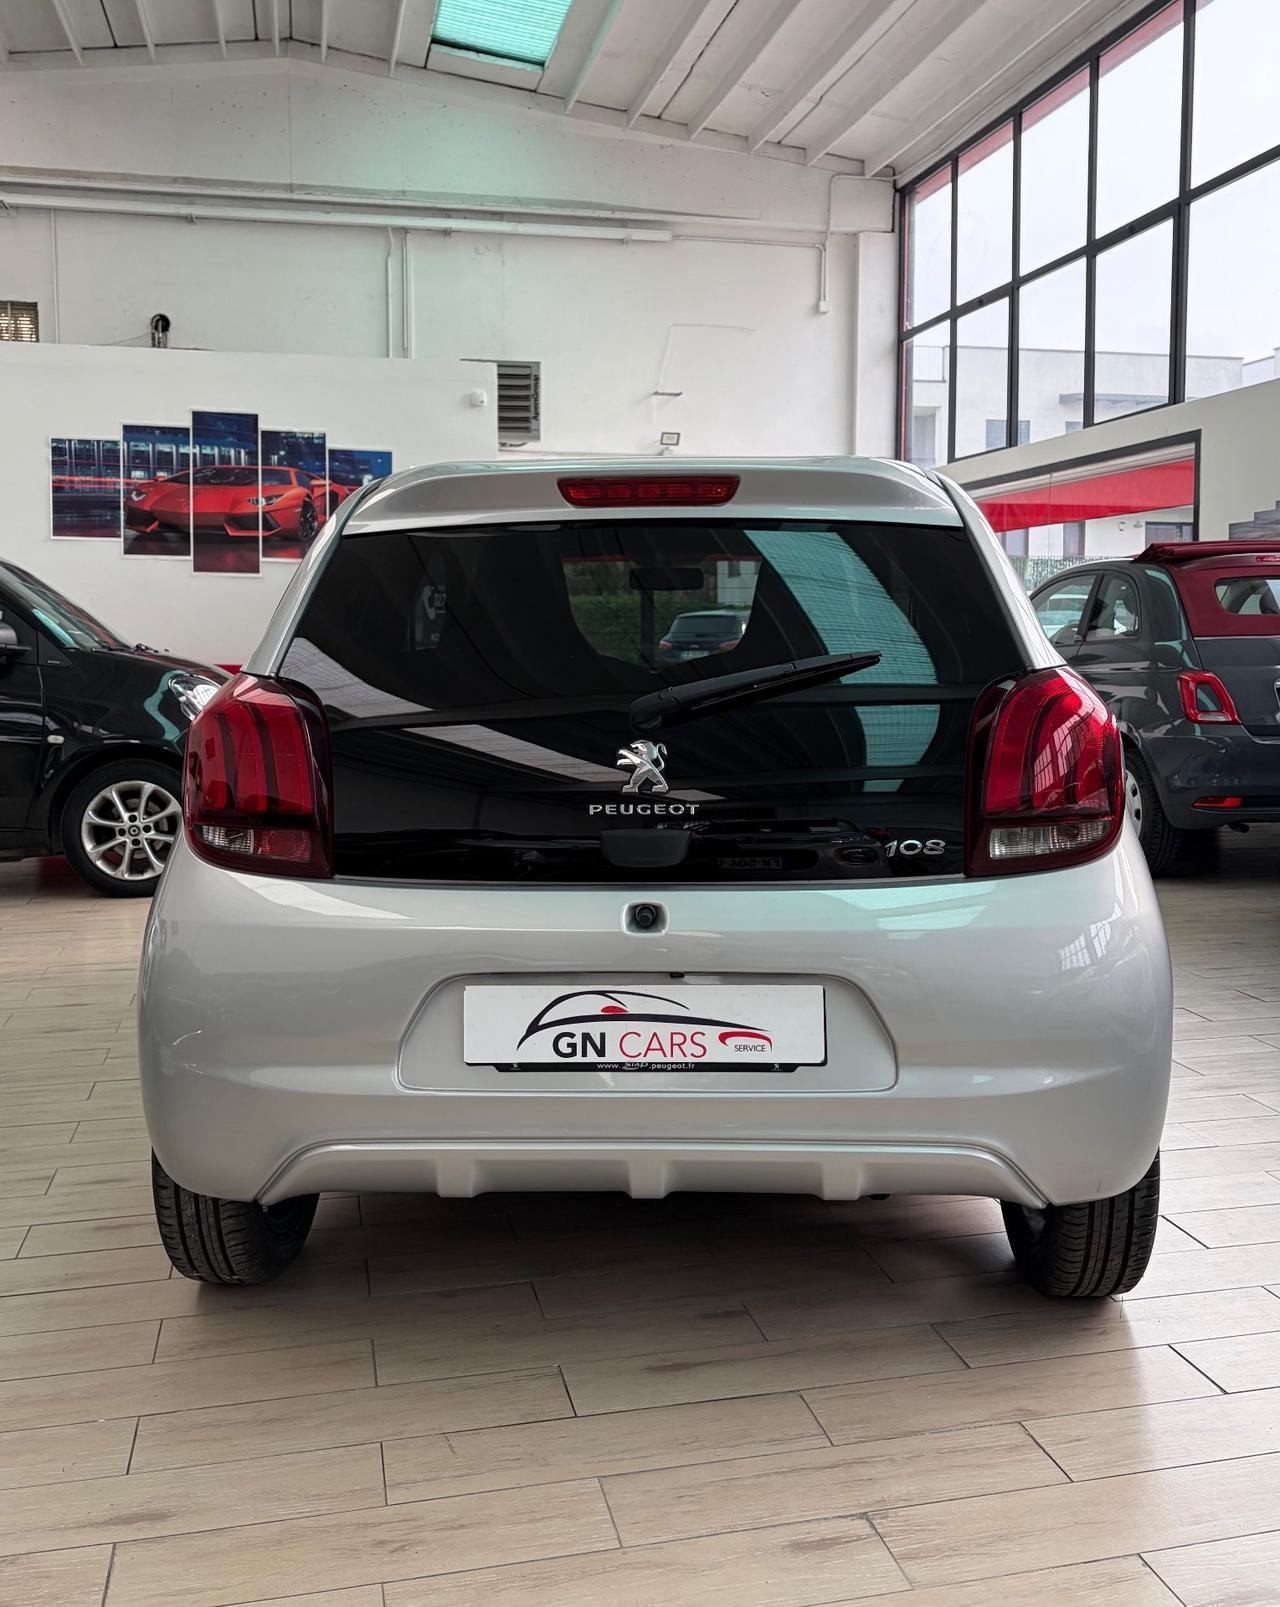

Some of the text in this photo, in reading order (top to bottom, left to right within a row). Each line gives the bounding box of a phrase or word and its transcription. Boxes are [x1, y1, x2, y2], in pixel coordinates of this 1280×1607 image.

[589, 804, 699, 815] PEUGEOT
[885, 840, 946, 857] 108
[553, 1031, 708, 1059] GN CARS
[734, 1044, 767, 1052] SERVICE
